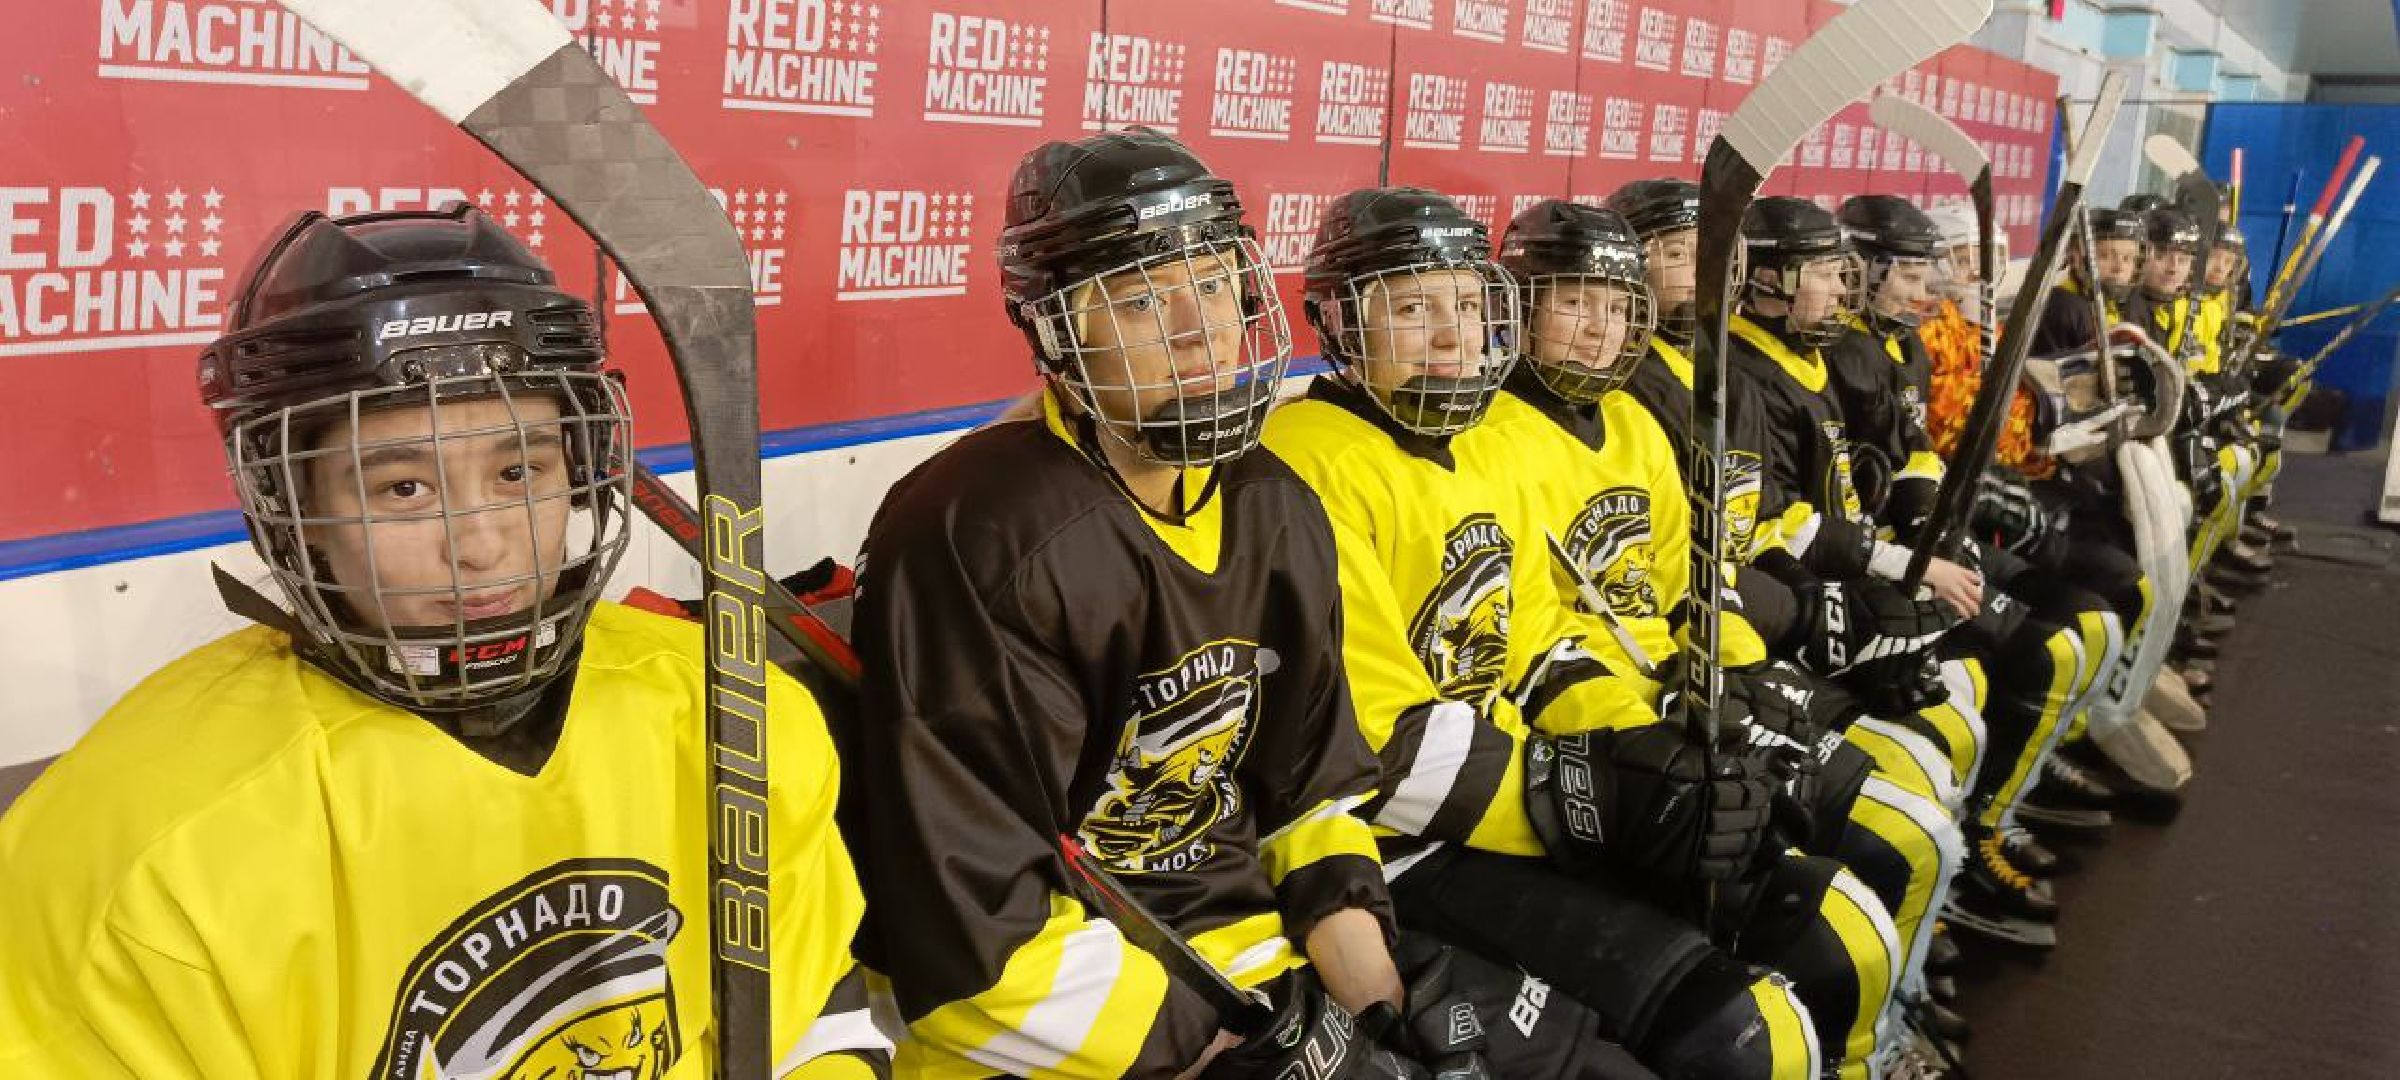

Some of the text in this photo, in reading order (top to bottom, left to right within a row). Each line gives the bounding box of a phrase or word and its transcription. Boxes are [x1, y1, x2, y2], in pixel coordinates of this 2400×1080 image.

[727, 0, 827, 53] RED
[930, 13, 1006, 70] RED
[723, 47, 878, 105] MACHINE
[1087, 31, 1150, 84] RED
[1214, 48, 1267, 93] RED
[926, 68, 1046, 116] MACHINE
[1083, 82, 1181, 123] MACHINE
[1320, 60, 1366, 103] RED
[1409, 73, 1447, 111] RED
[1484, 82, 1516, 118] RED
[1211, 94, 1292, 131] MACHINE
[1316, 102, 1384, 136] MACHINE
[1405, 111, 1464, 143] MACHINE
[0, 187, 115, 268] ED
[841, 190, 927, 243] RED
[1266, 193, 1314, 232] RED
[838, 245, 970, 289] MACHINE
[380, 310, 512, 340] BAUER
[1822, 582, 1847, 667] CCM
[704, 494, 770, 972] BAUER
[409, 884, 624, 1017] ТОРНАДО
